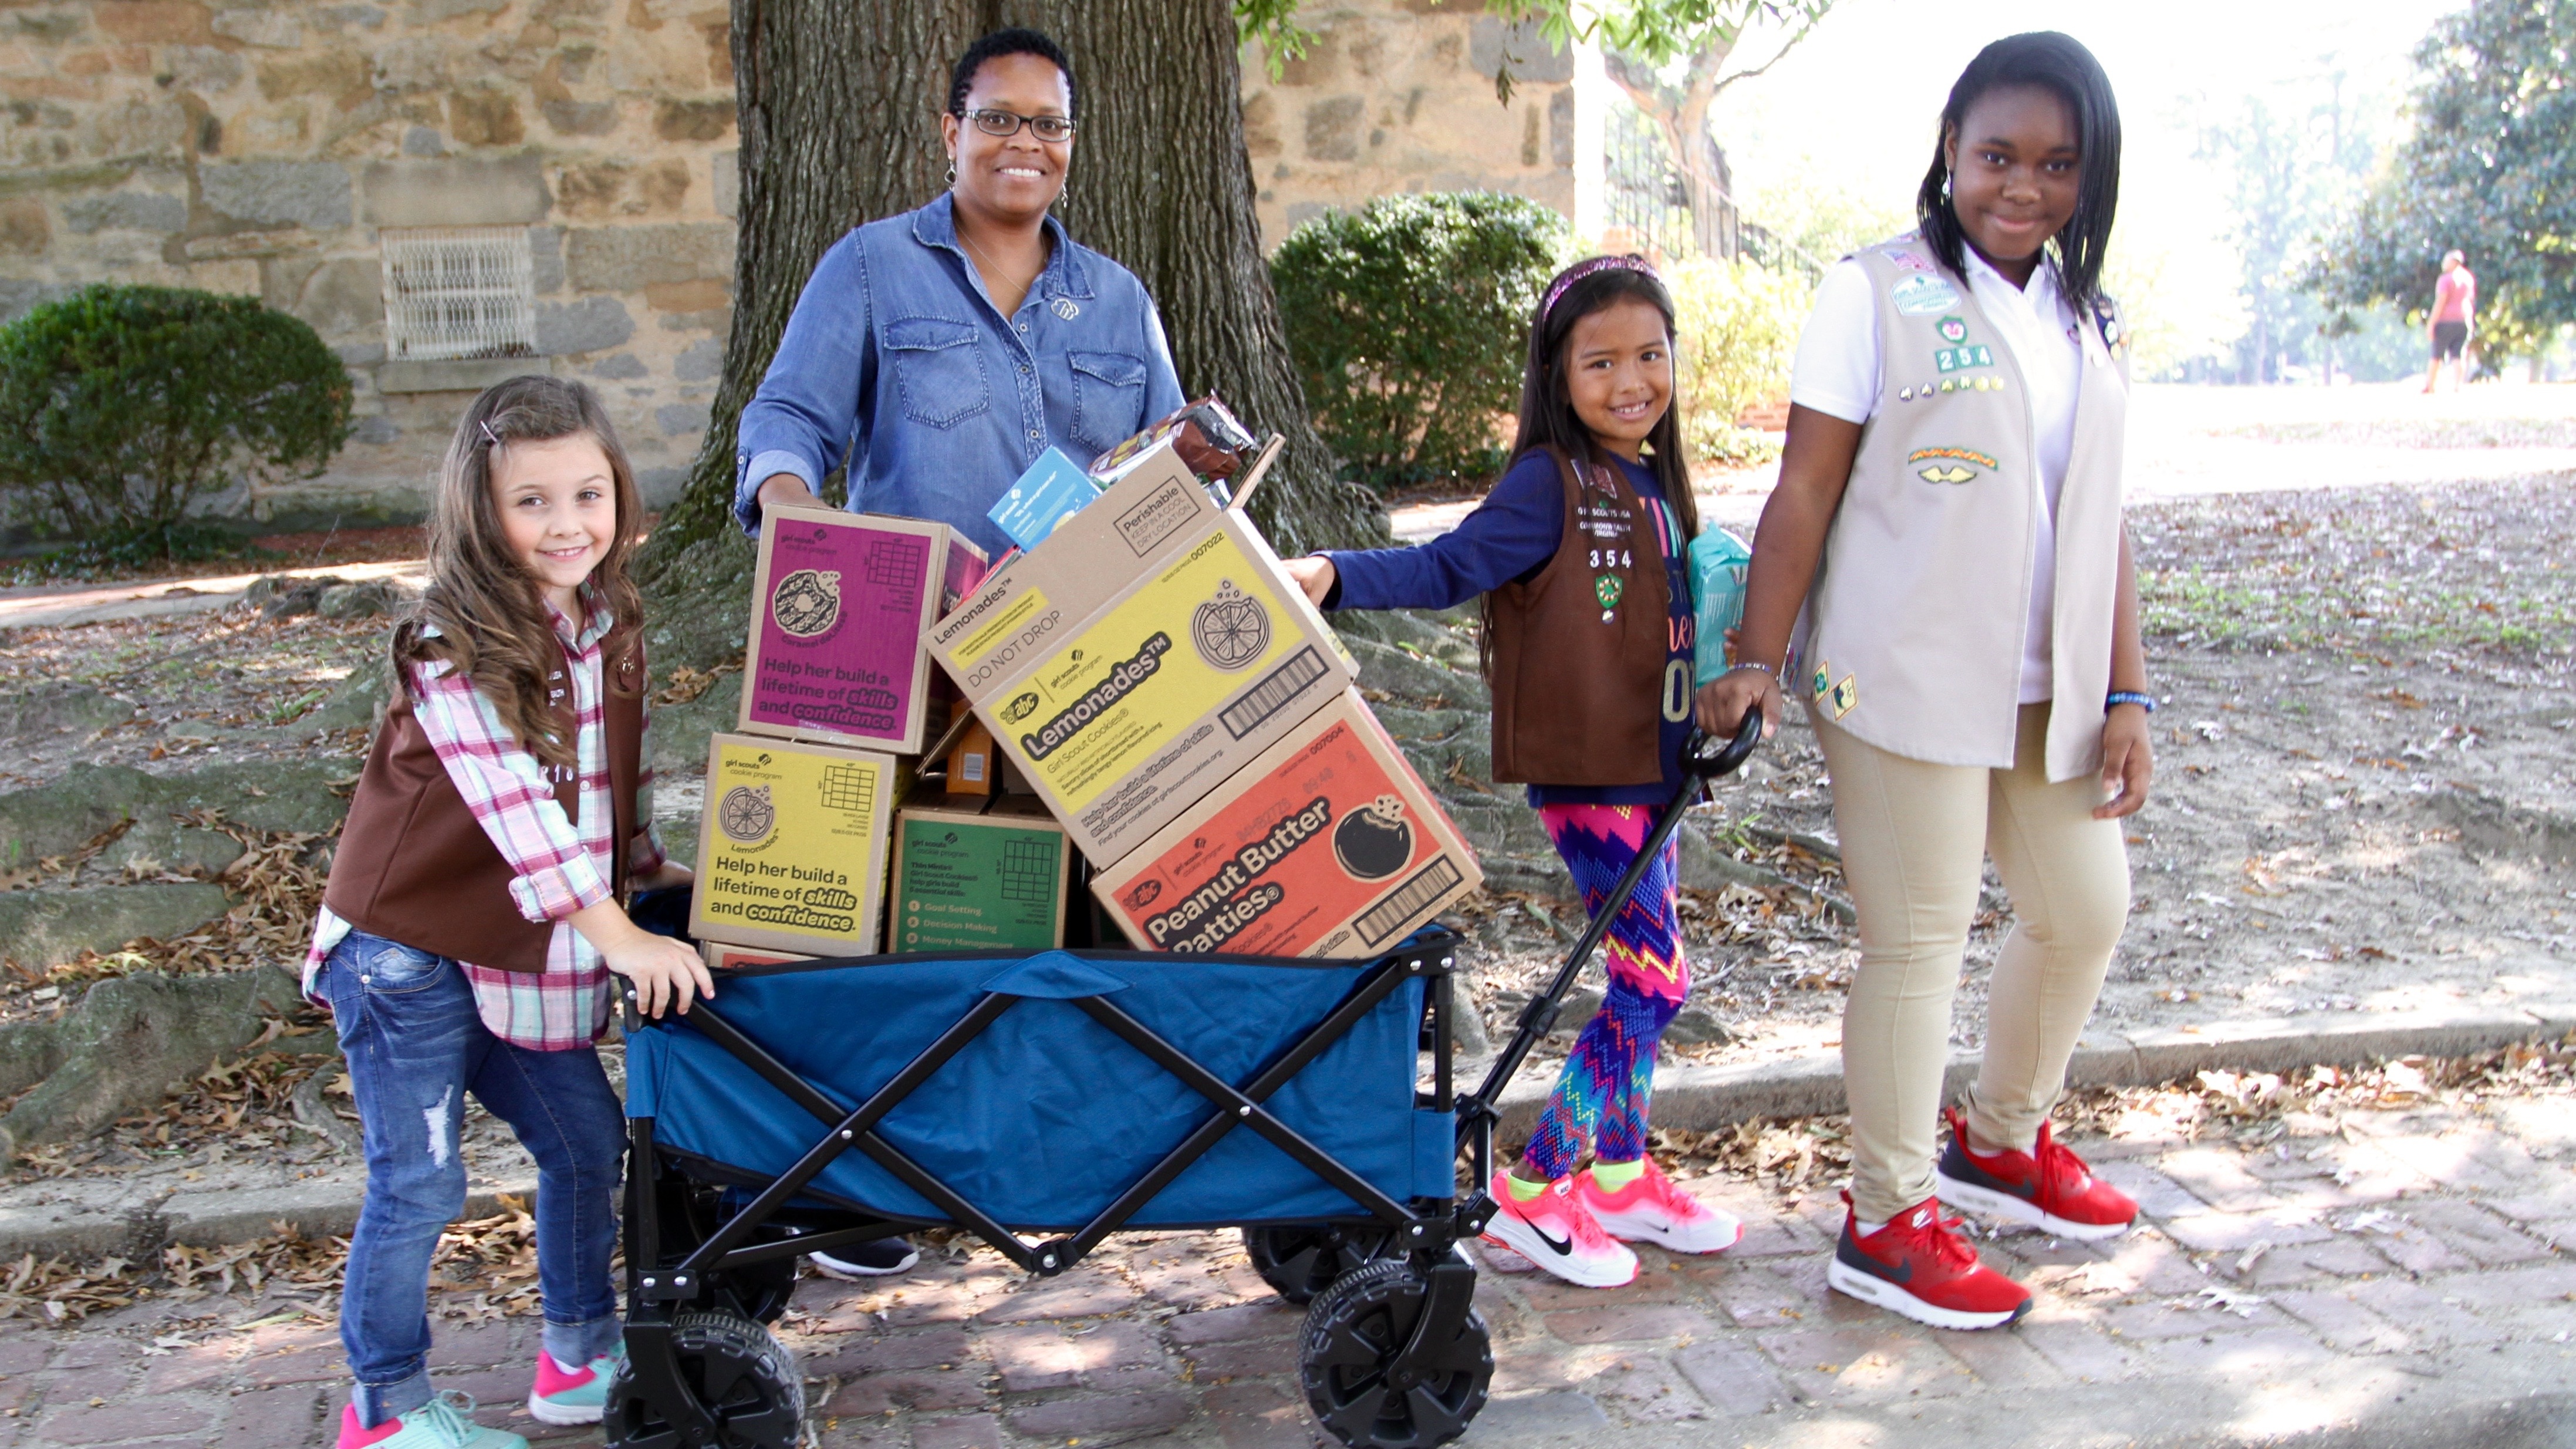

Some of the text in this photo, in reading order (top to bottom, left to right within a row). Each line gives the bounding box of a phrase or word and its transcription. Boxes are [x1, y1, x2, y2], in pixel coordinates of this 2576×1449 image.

[1940, 348, 1990, 371] 254
[1123, 488, 1179, 532] Perishable
[1131, 523, 1148, 540] KEEP
[1163, 497, 1185, 514] COOL
[1137, 504, 1191, 548] DRY LOCATION
[1191, 533, 1224, 560] 007022
[1589, 550, 1632, 568] 354
[968, 611, 1059, 688] DO NOT DROP
[764, 658, 889, 686] Help her build a
[1051, 663, 1079, 688] girl scouts
[1060, 655, 1102, 689] cookie program
[762, 678, 897, 709] lifetime of skills
[759, 700, 896, 731] and confidence.
[1309, 726, 1343, 754] 007004
[725, 759, 737, 768] girl
[1047, 758, 1064, 773] Girl
[1062, 740, 1089, 762] Scout
[730, 768, 782, 781] cookie program
[1081, 724, 1214, 828] Help her build a lifetime of skills
[1091, 819, 1110, 838] and
[1098, 832, 1113, 847] Find
[1112, 821, 1127, 837] your
[1127, 804, 1152, 824] cookies
[1152, 797, 1160, 806] at
[717, 857, 848, 885] Help her build a
[1148, 800, 1326, 943] Peanut Butter
[714, 877, 856, 909] lifetime of skills
[711, 902, 856, 932] and confidence.
[924, 903, 947, 913] Goal
[923, 919, 963, 929] Decision
[965, 922, 997, 934] Making
[923, 936, 953, 946] Money
